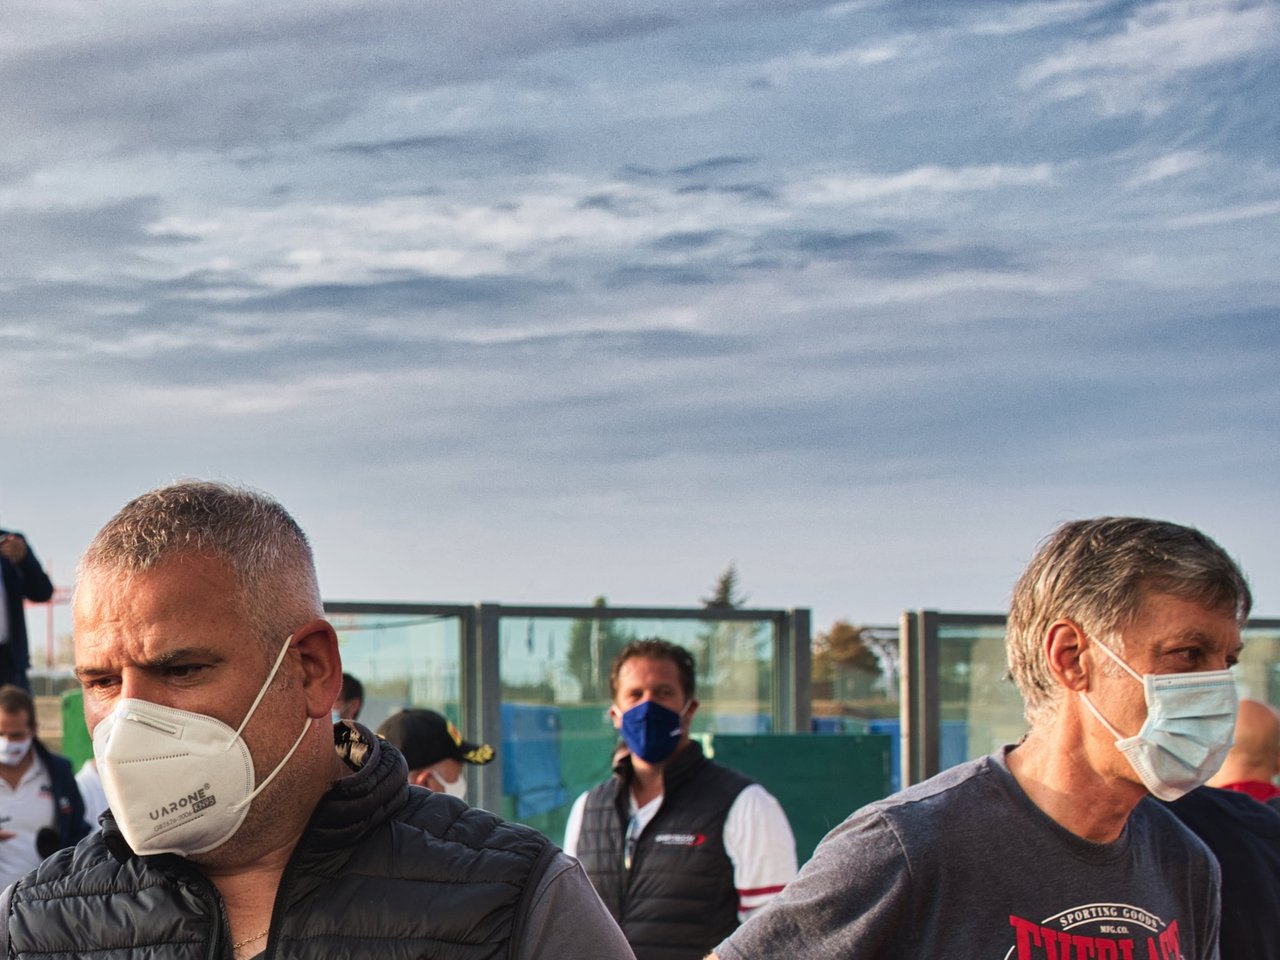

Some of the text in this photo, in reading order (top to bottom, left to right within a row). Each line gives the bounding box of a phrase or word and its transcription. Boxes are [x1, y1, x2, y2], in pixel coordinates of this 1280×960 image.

[192, 795, 216, 813] KN95
[1060, 907, 1158, 928] SPORTING GOODS
